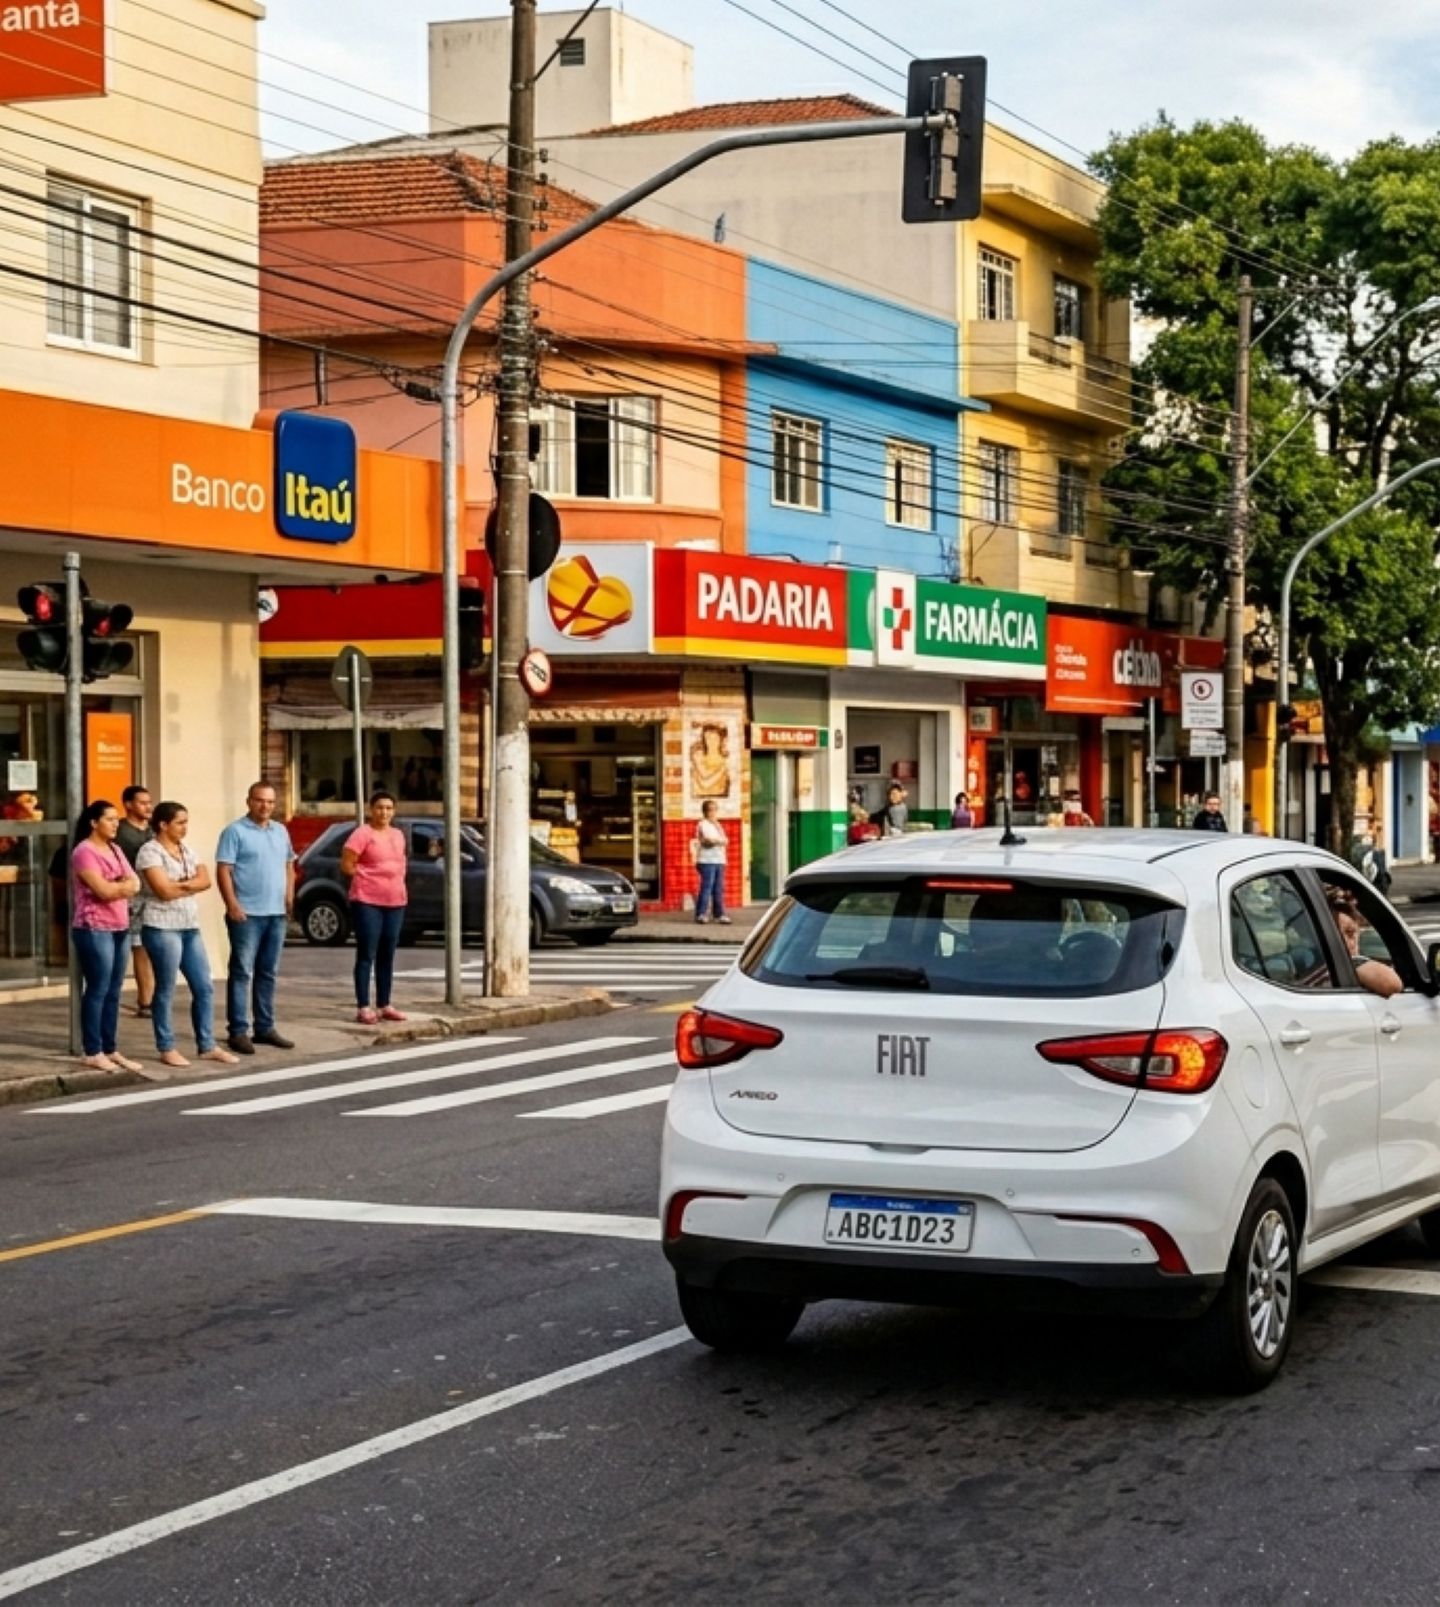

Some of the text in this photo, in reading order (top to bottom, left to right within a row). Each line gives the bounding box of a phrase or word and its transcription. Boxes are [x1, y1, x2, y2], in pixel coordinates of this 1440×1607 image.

[172, 463, 352, 525] Banco Itaú
[697, 572, 834, 632] PADARIA
[924, 597, 1039, 650] FARMÁCIA
[876, 1034, 931, 1077] FIAT
[838, 1212, 956, 1244] ABC1D23
